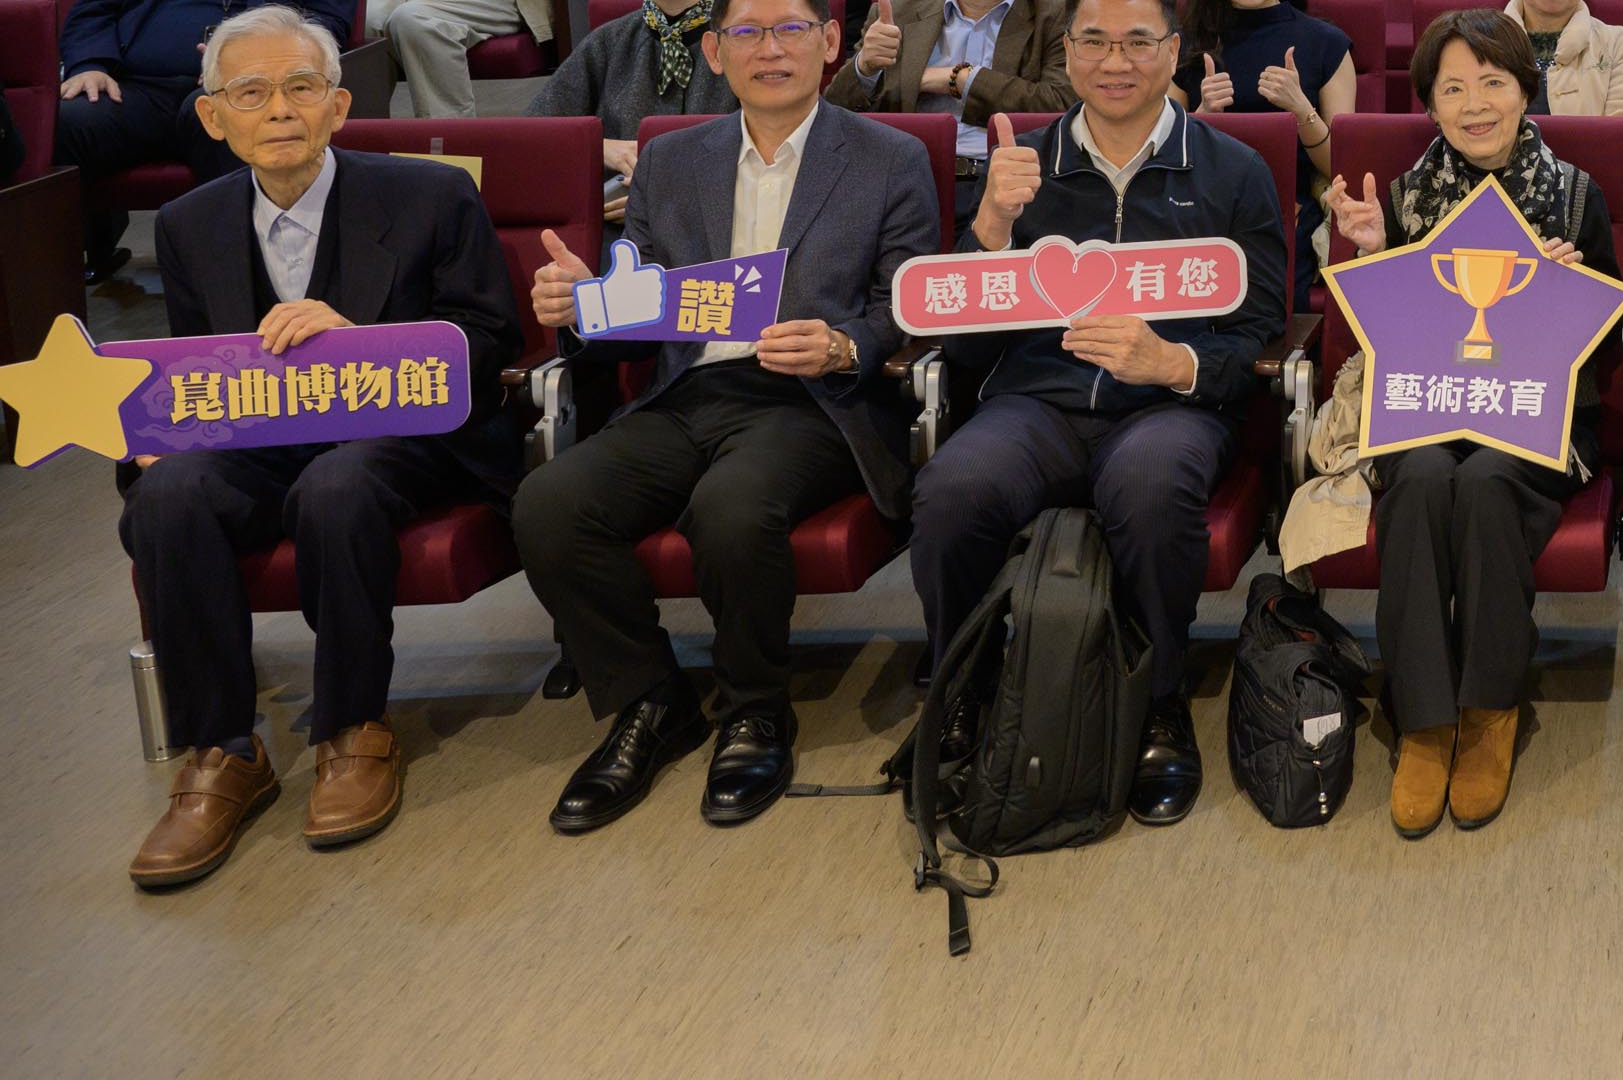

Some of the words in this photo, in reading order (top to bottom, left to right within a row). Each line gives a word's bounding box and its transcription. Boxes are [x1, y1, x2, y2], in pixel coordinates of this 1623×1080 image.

[677, 278, 735, 336] 讚
[924, 270, 1020, 315] 感恩
[1125, 257, 1220, 302] 有您
[170, 356, 450, 425] 崑曲博物館
[1383, 372, 1548, 417] 藝術教育
